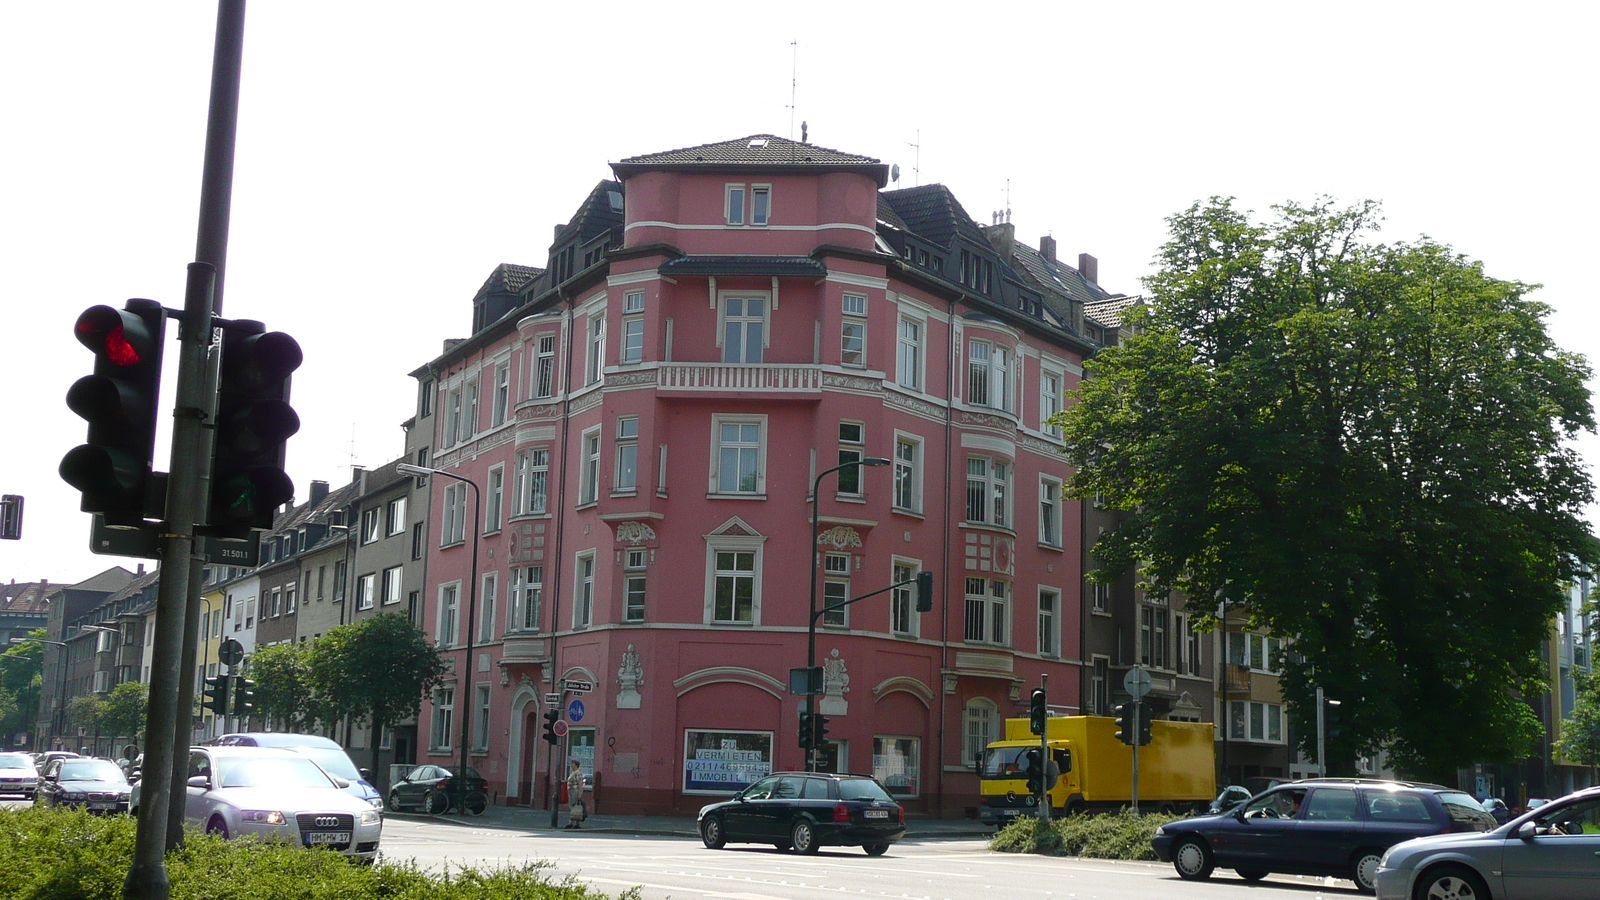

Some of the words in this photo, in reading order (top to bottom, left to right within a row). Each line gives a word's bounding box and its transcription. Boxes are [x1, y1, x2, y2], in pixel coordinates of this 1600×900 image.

[222, 549, 248, 558] 31.501.1
[722, 741, 736, 750] ZU
[697, 751, 761, 760] VERMIETEN
[312, 834, 322, 842] HM
[326, 834, 336, 842] HW
[340, 834, 348, 842] 17
